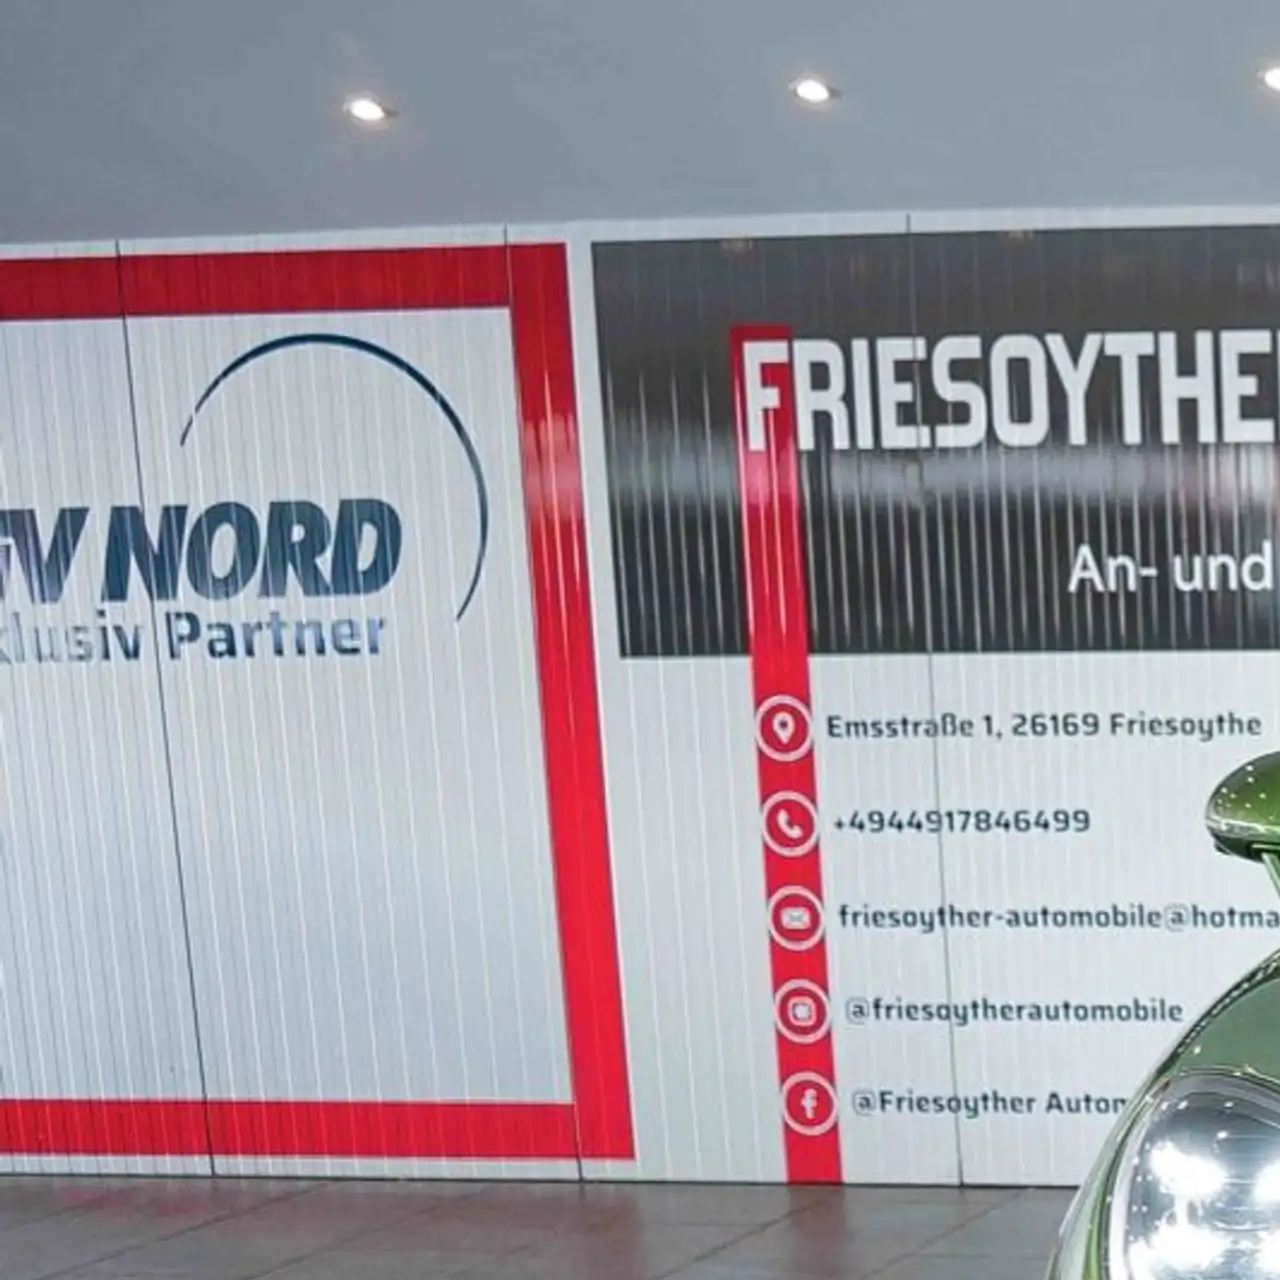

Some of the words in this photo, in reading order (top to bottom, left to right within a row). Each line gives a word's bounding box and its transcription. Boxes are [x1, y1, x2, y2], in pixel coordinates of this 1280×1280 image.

[0, 508, 90, 604] V
[100, 498, 401, 603] NORD
[1067, 543, 1158, 594] An-
[1173, 541, 1273, 592] und
[0, 609, 144, 666] lusiv
[162, 611, 386, 661] Partner
[827, 713, 974, 739] Emsstraße
[981, 714, 1003, 740] 1,
[1012, 712, 1099, 737] 26169
[1110, 711, 1263, 743] Friesoythe
[834, 809, 1091, 833] +4944917846499
[846, 996, 1183, 1027] @friesoytherautomobile
[853, 1089, 1036, 1121] @Friesoyther
